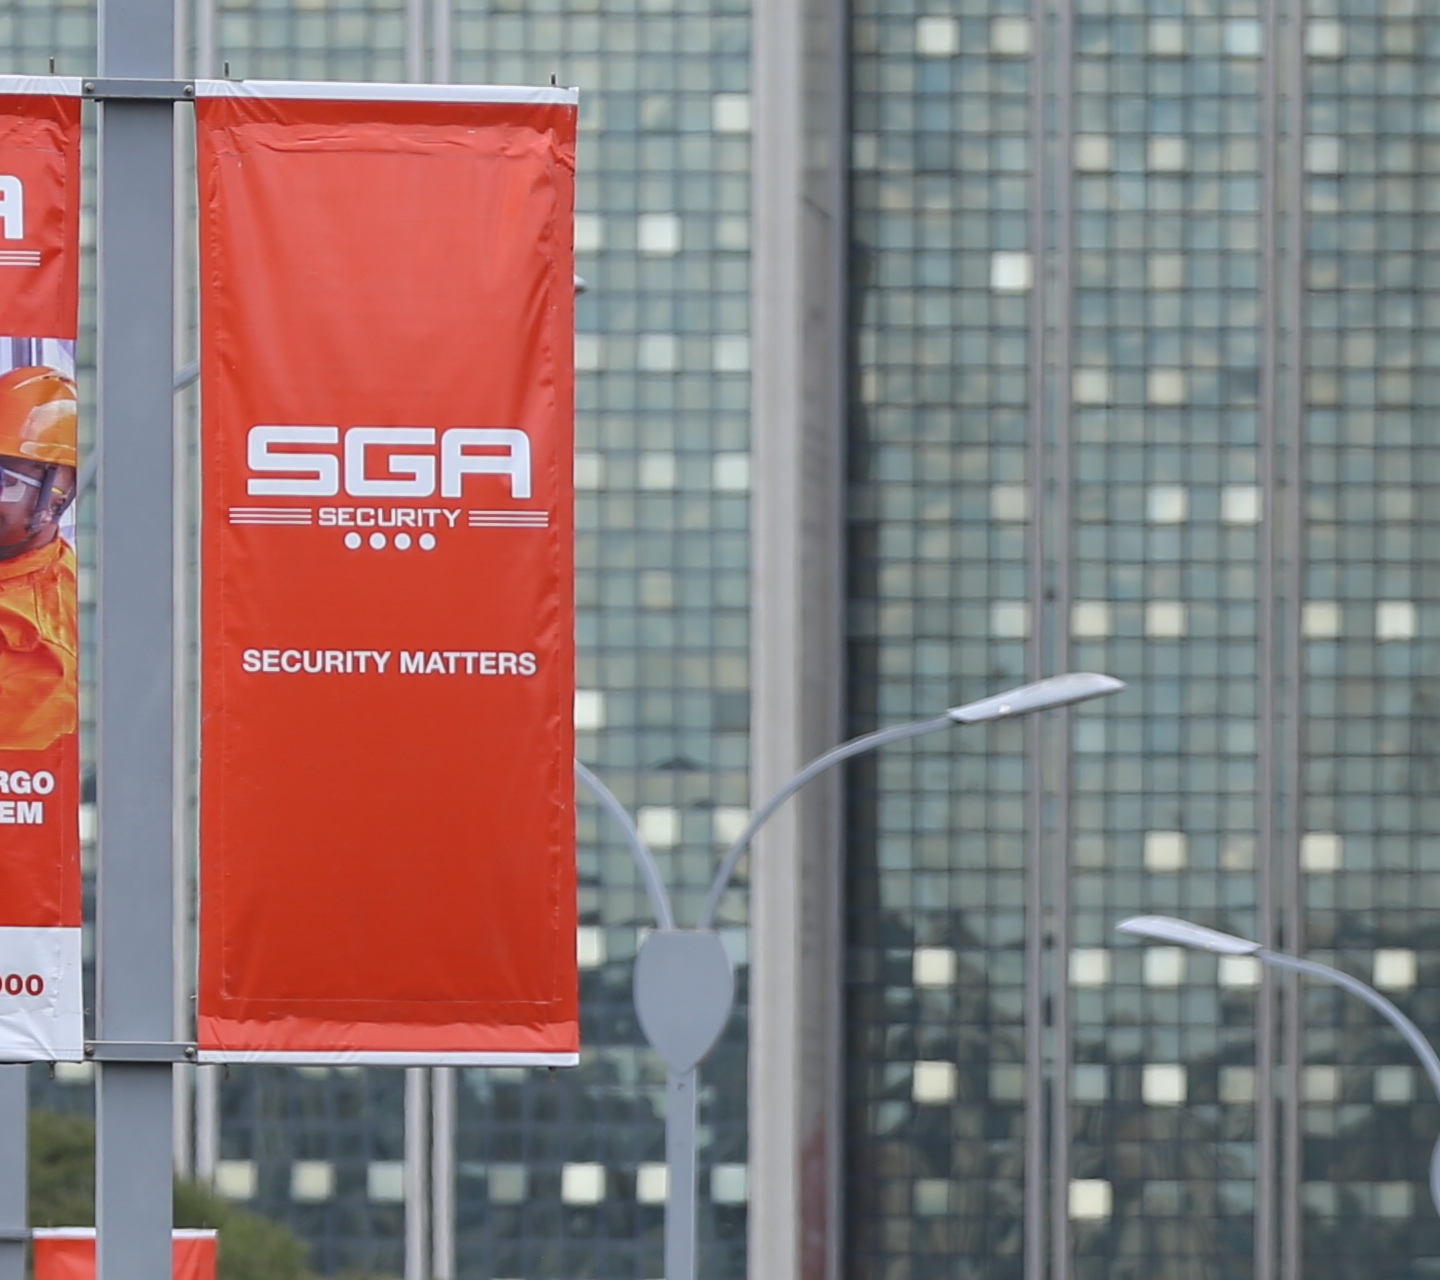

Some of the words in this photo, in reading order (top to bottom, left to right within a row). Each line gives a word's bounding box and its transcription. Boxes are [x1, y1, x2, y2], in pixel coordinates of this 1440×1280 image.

[247, 425, 532, 499] SGA
[318, 507, 461, 528] SECURITY
[242, 649, 391, 673] SECURITY
[400, 651, 537, 676] MATTERS
